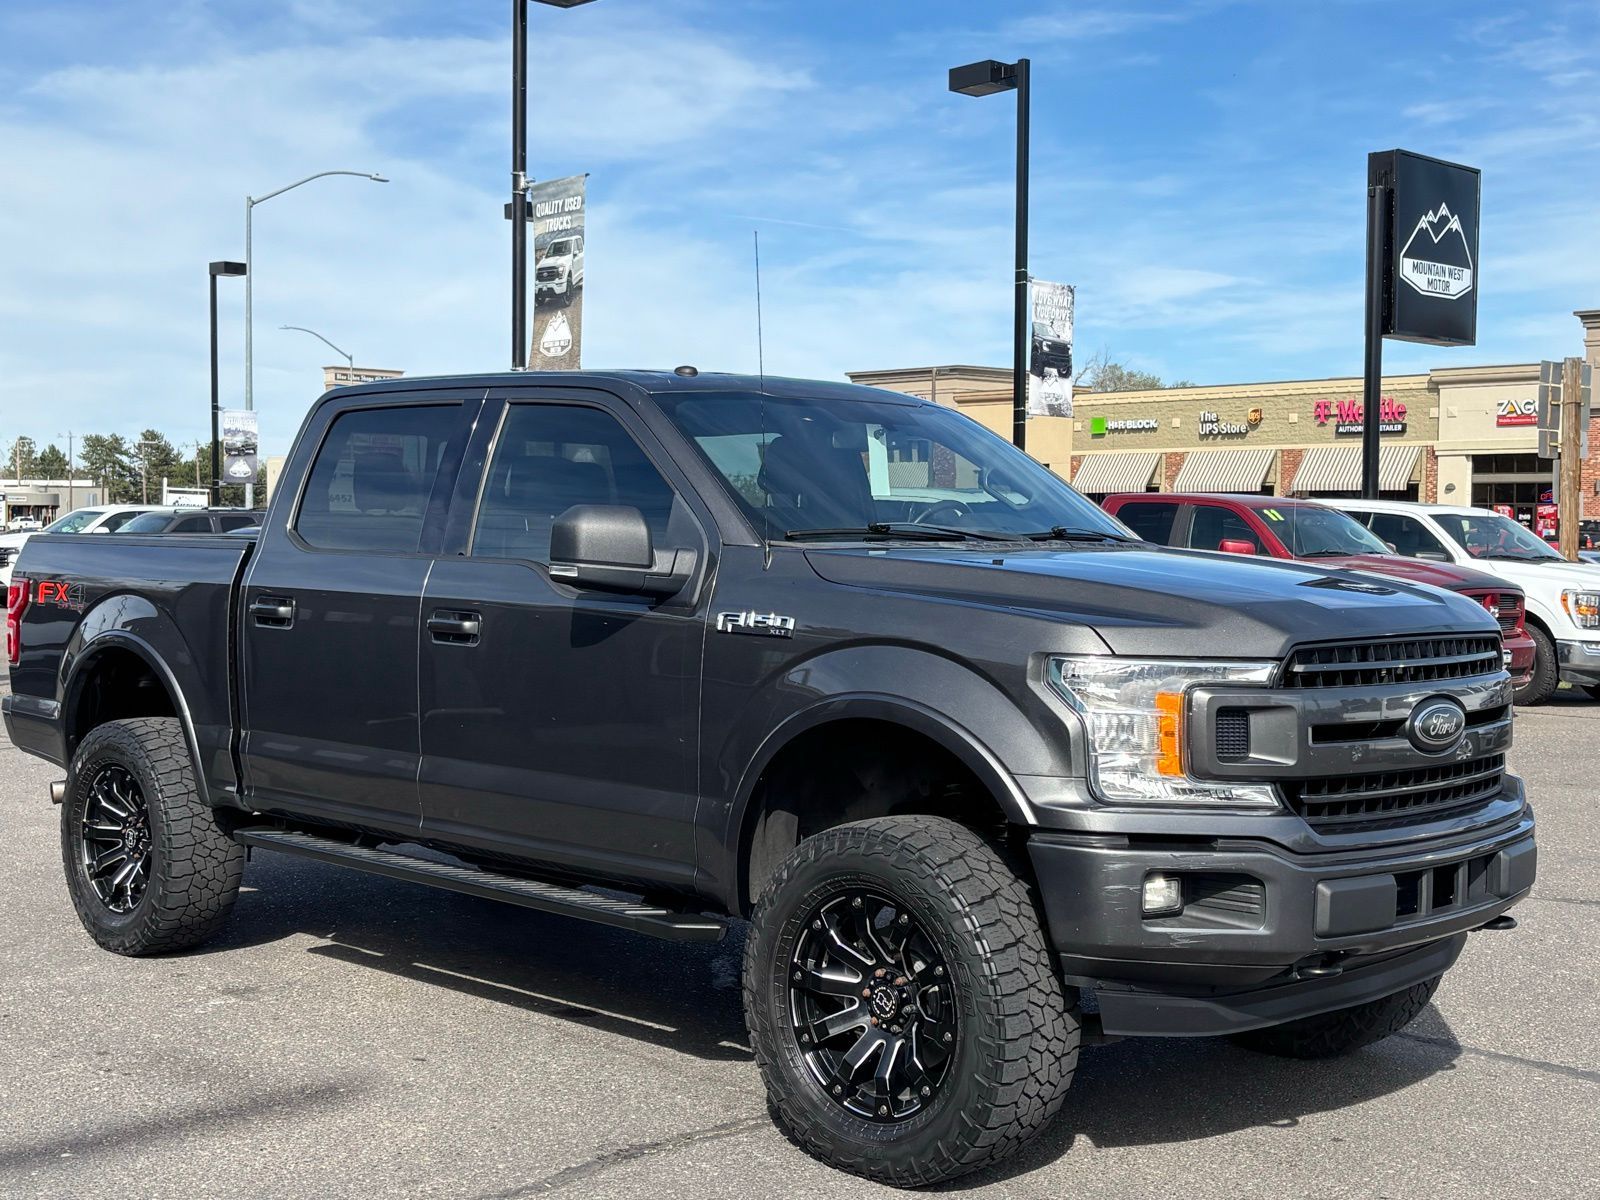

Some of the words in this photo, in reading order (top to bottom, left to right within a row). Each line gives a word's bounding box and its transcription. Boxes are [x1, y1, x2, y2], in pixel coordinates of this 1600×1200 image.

[536, 199, 563, 218] QUALITY
[564, 195, 582, 214] USED
[545, 216, 572, 233] TRUCKS
[1412, 260, 1447, 279] MOUNTAIN
[1447, 266, 1464, 282] WEST
[1427, 277, 1451, 292] MOTOR
[1199, 410, 1218, 422] The
[1497, 399, 1539, 416] ZAG
[1126, 419, 1158, 429] BLOCK
[1199, 422, 1219, 435] UPS
[1220, 422, 1247, 434] Store
[38, 581, 86, 604] FX4
[1430, 713, 1457, 736] Ford
